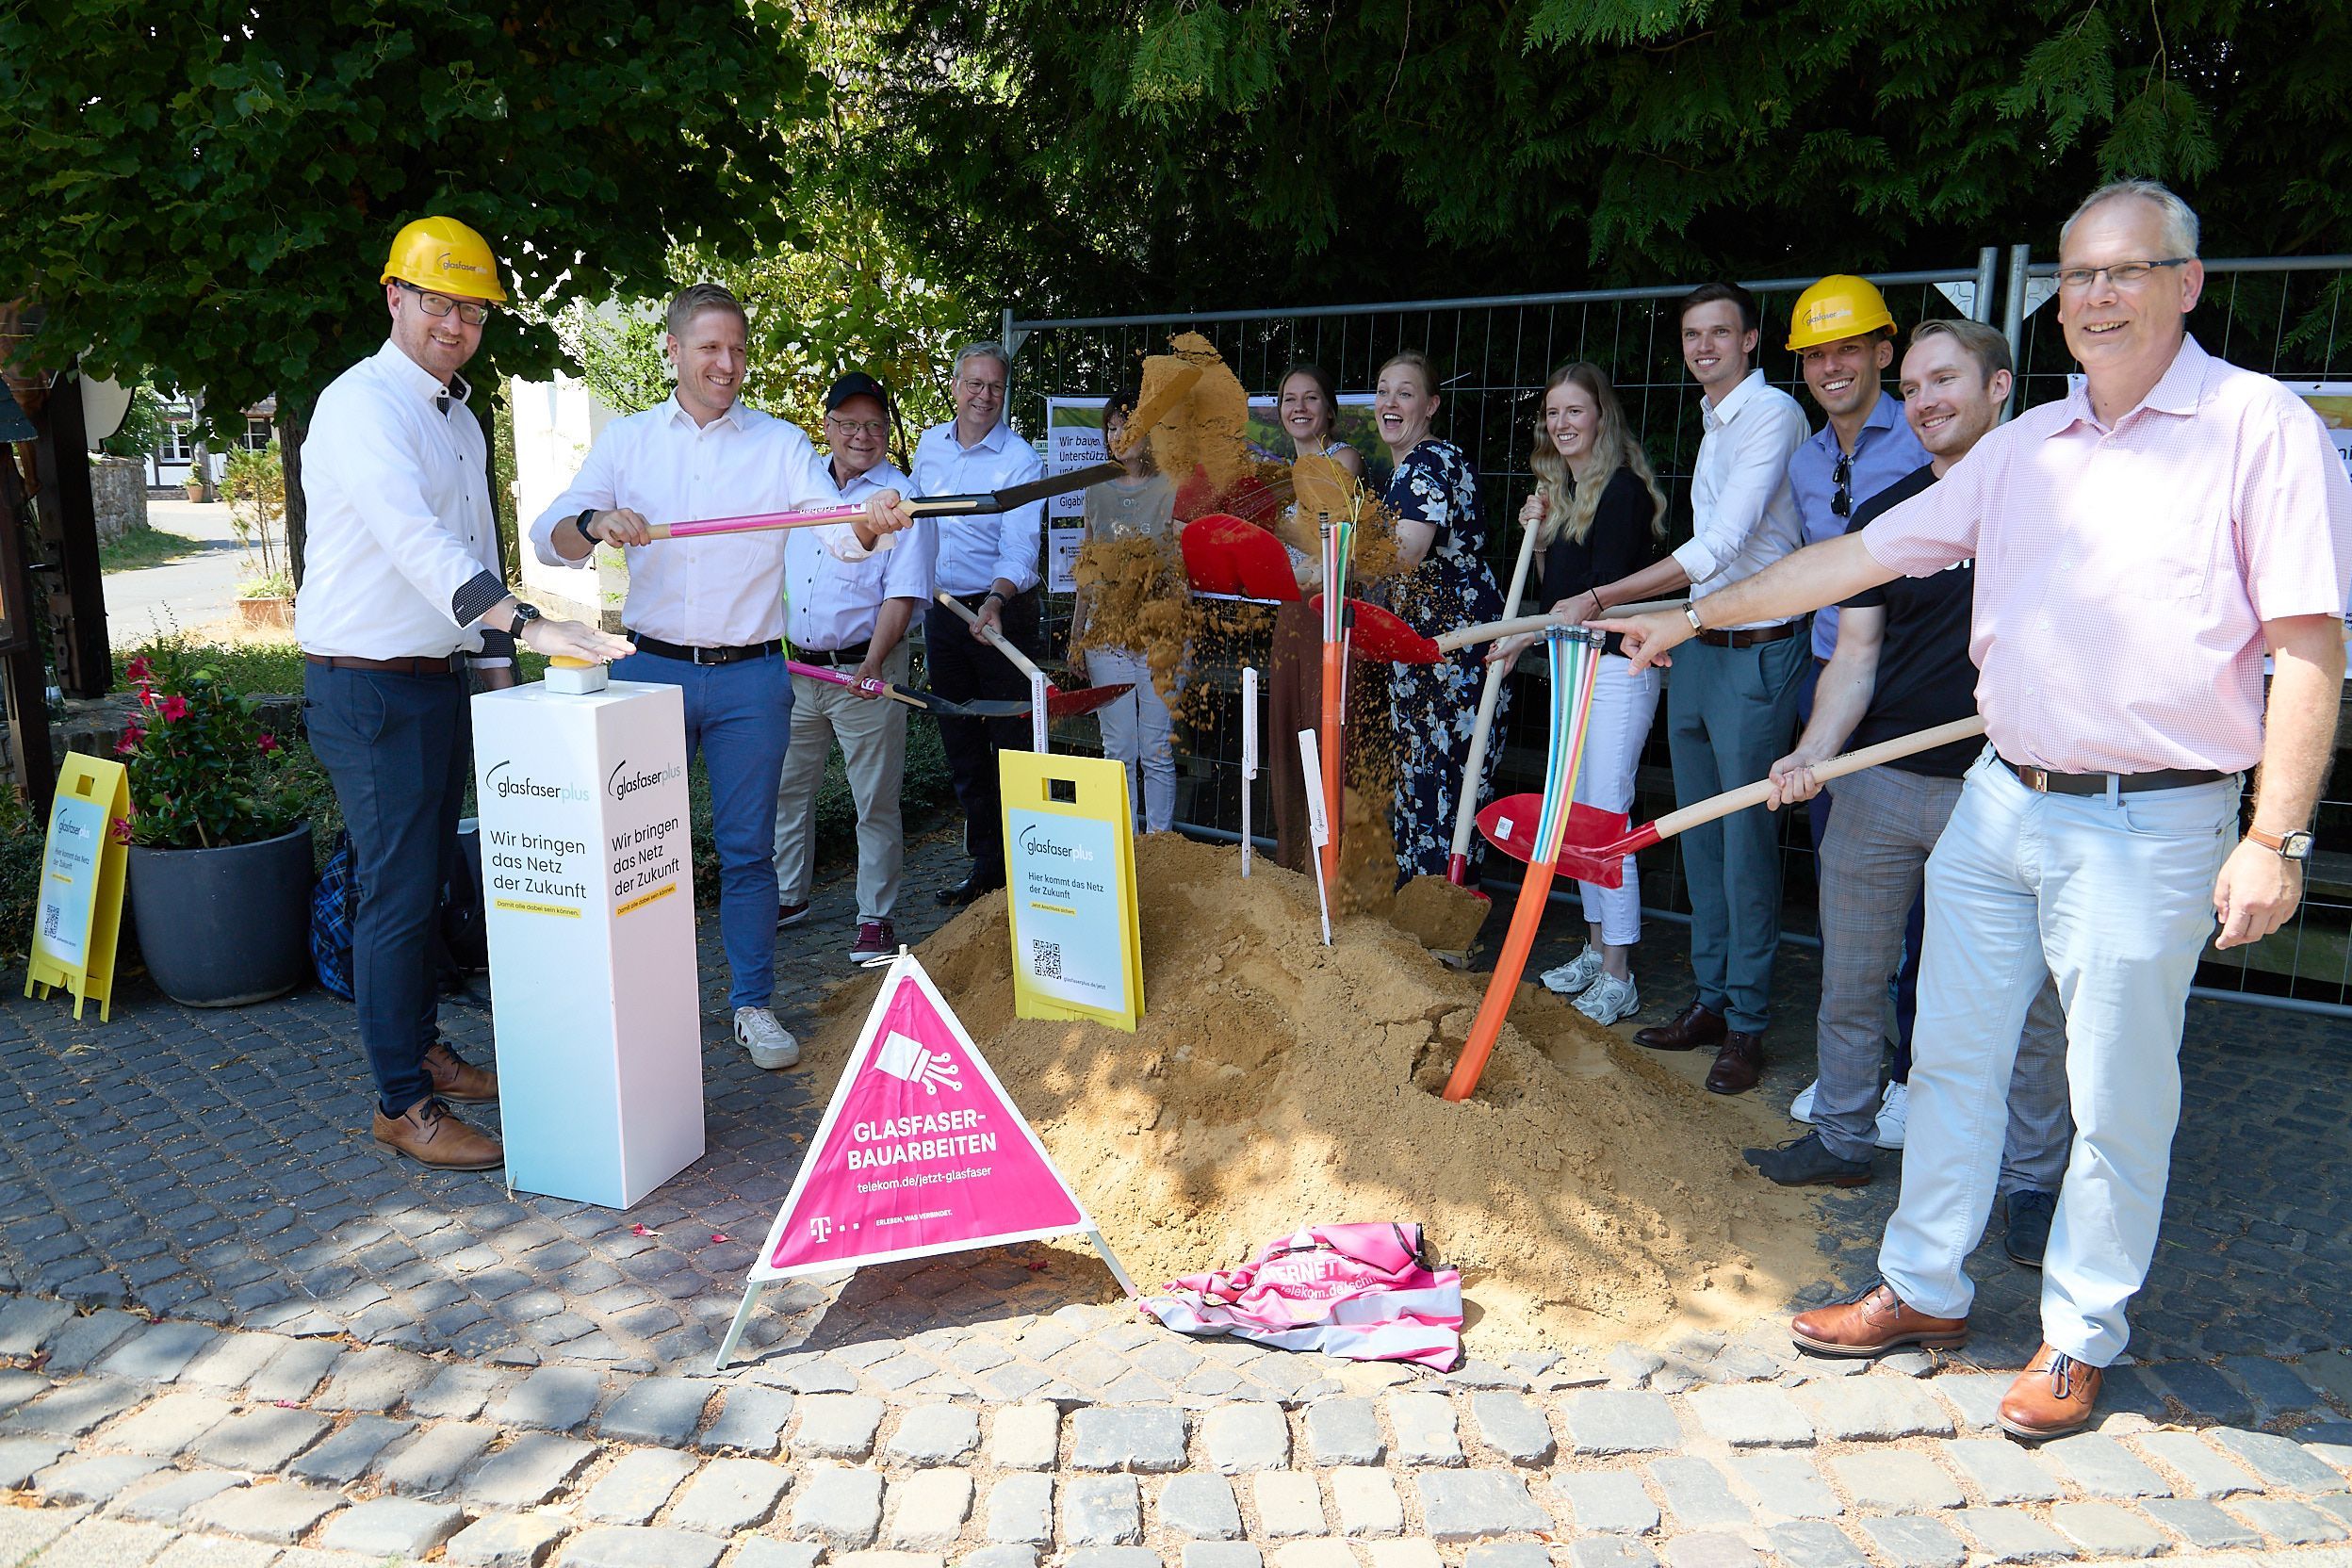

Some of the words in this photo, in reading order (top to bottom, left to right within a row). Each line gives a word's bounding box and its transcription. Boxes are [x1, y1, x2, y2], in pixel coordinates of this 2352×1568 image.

[1059, 436, 1073, 446] Wir
[1076, 435, 1102, 446] bauen
[498, 776, 590, 804] glasfaserplus
[616, 762, 681, 801] glasfaserplus
[490, 830, 516, 846] Wir
[521, 833, 586, 857] bringen
[612, 833, 631, 852] Wir
[634, 818, 678, 843] bringen
[613, 856, 636, 874] das
[639, 844, 663, 865] Netz
[1027, 837, 1094, 862] glasfaserplus
[492, 853, 522, 869] das
[527, 857, 563, 874] Netz
[493, 874, 520, 890] der
[525, 877, 587, 899] Zukunft
[614, 879, 635, 896] der
[637, 858, 679, 888] Zukunft
[1028, 872, 1043, 882] Hier
[1044, 874, 1070, 887] kommt
[1071, 879, 1086, 890] das
[1086, 881, 1104, 892] Netz
[1029, 885, 1041, 894] der
[1042, 886, 1070, 899] Zukunft
[497, 900, 514, 908] Damit
[526, 903, 543, 912] dabei
[617, 905, 630, 915] Damit
[853, 1108, 987, 1143] GLASFASER-
[847, 1132, 997, 1170] BAUARBEITEN
[857, 1167, 992, 1194] telekom.de/jetzt-glasfaser
[875, 1217, 904, 1227] ERLEBEN,
[904, 1214, 919, 1222] WAS
[919, 1209, 954, 1220] VERBINDET.
